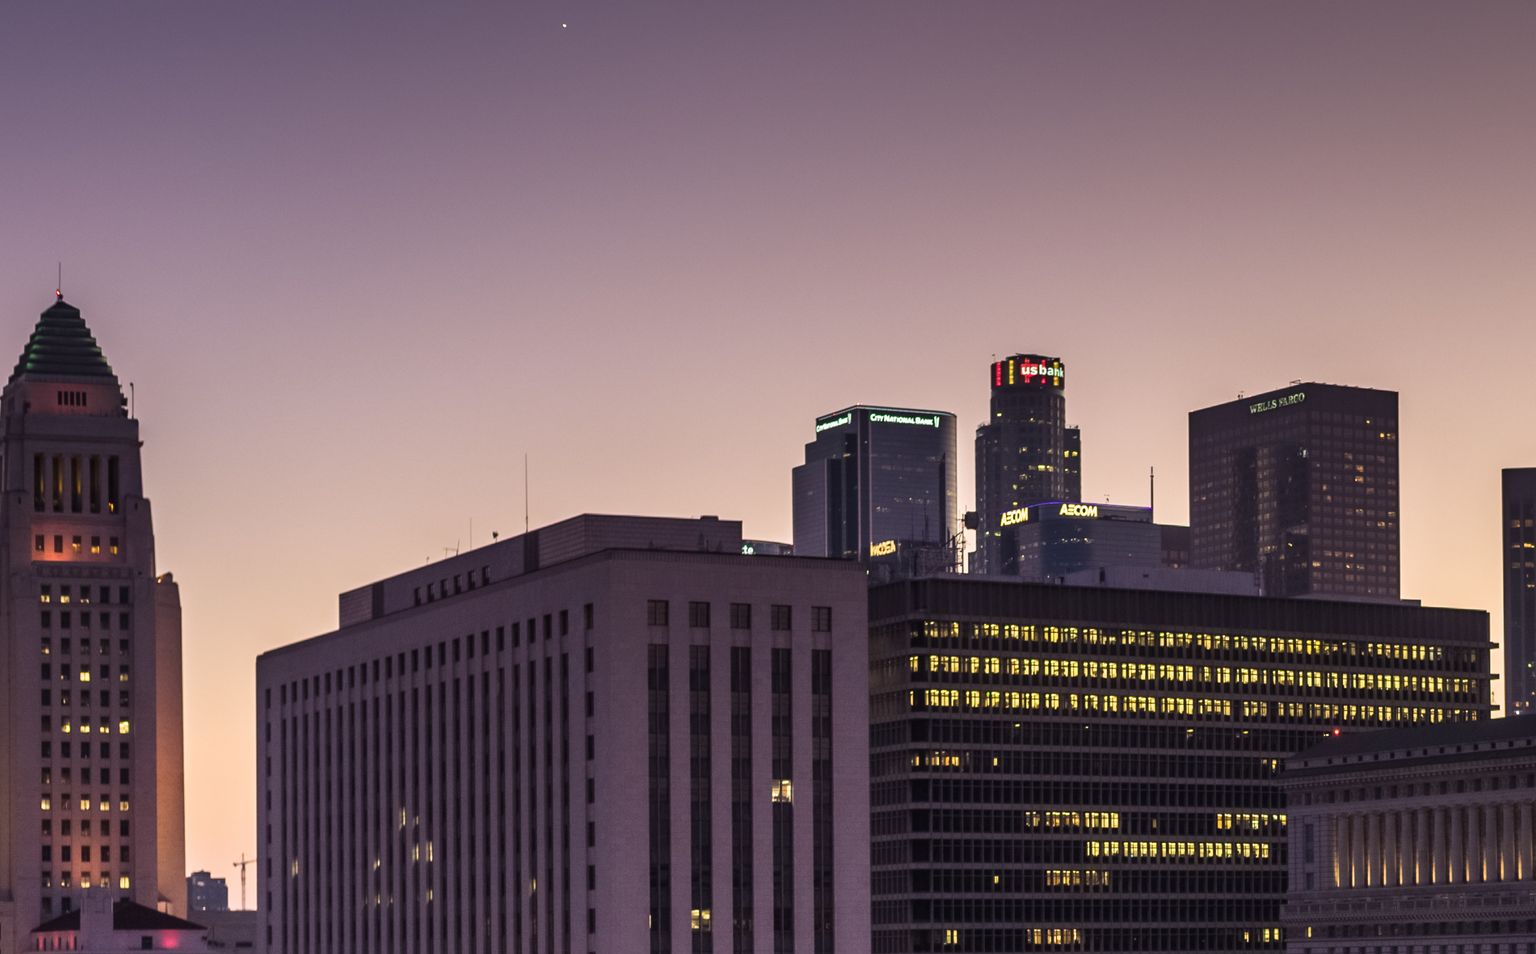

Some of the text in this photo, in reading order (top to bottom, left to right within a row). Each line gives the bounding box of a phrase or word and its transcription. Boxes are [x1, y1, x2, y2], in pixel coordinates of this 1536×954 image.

[1249, 392, 1306, 414] WELLS FARGO
[870, 413, 934, 426] CITY NATIONAL BANK
[1000, 507, 1028, 526] AECOM
[1059, 503, 1098, 517] AECOM
